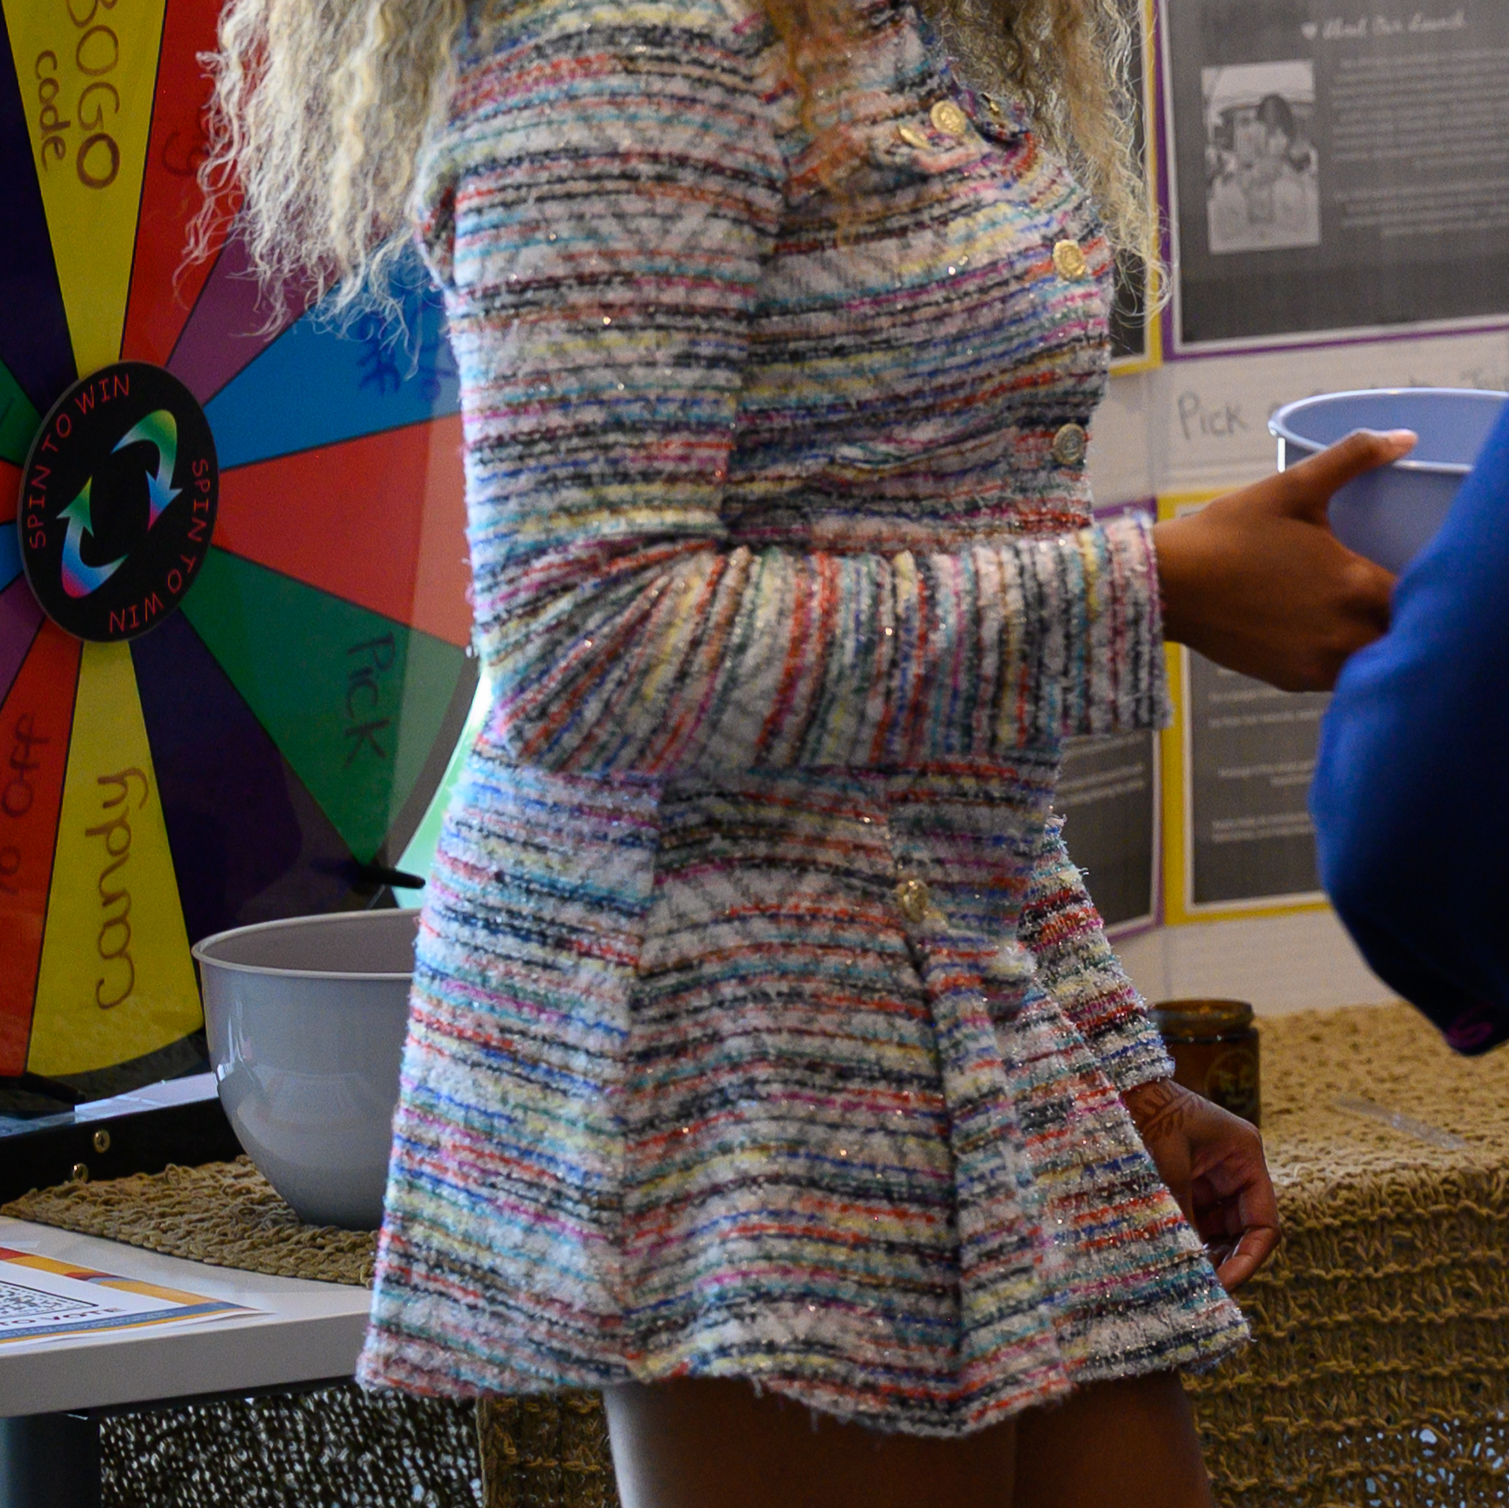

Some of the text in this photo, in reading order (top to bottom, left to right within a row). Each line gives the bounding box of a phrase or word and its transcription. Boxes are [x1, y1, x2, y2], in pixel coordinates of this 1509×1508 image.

[35, 49, 71, 172] code
[27, 373, 130, 550] SPIN TO WIN
[1176, 394, 1247, 441] Pick
[108, 458, 210, 634] SPIN TO WIN
[344, 630, 396, 769] Pick
[84, 767, 149, 1011] candy
